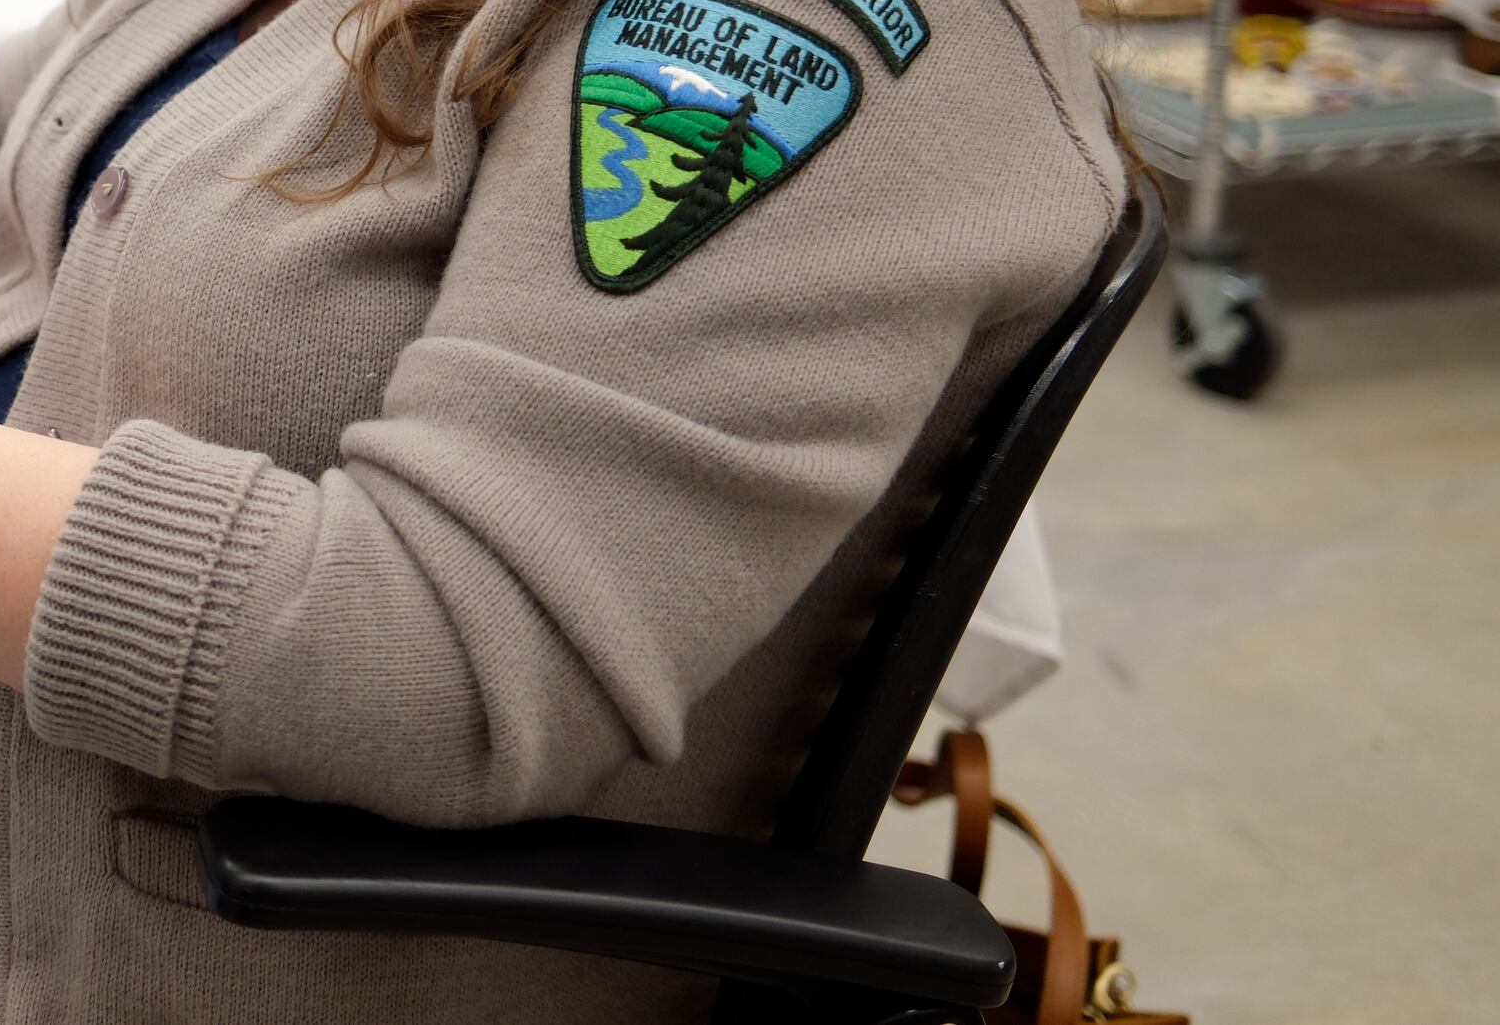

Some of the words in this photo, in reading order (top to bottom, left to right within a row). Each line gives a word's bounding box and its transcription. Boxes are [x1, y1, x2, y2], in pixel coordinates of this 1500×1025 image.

[614, 20, 804, 105] MANAGEMENT
[713, 16, 759, 49] OF
[762, 35, 839, 92] LAND
